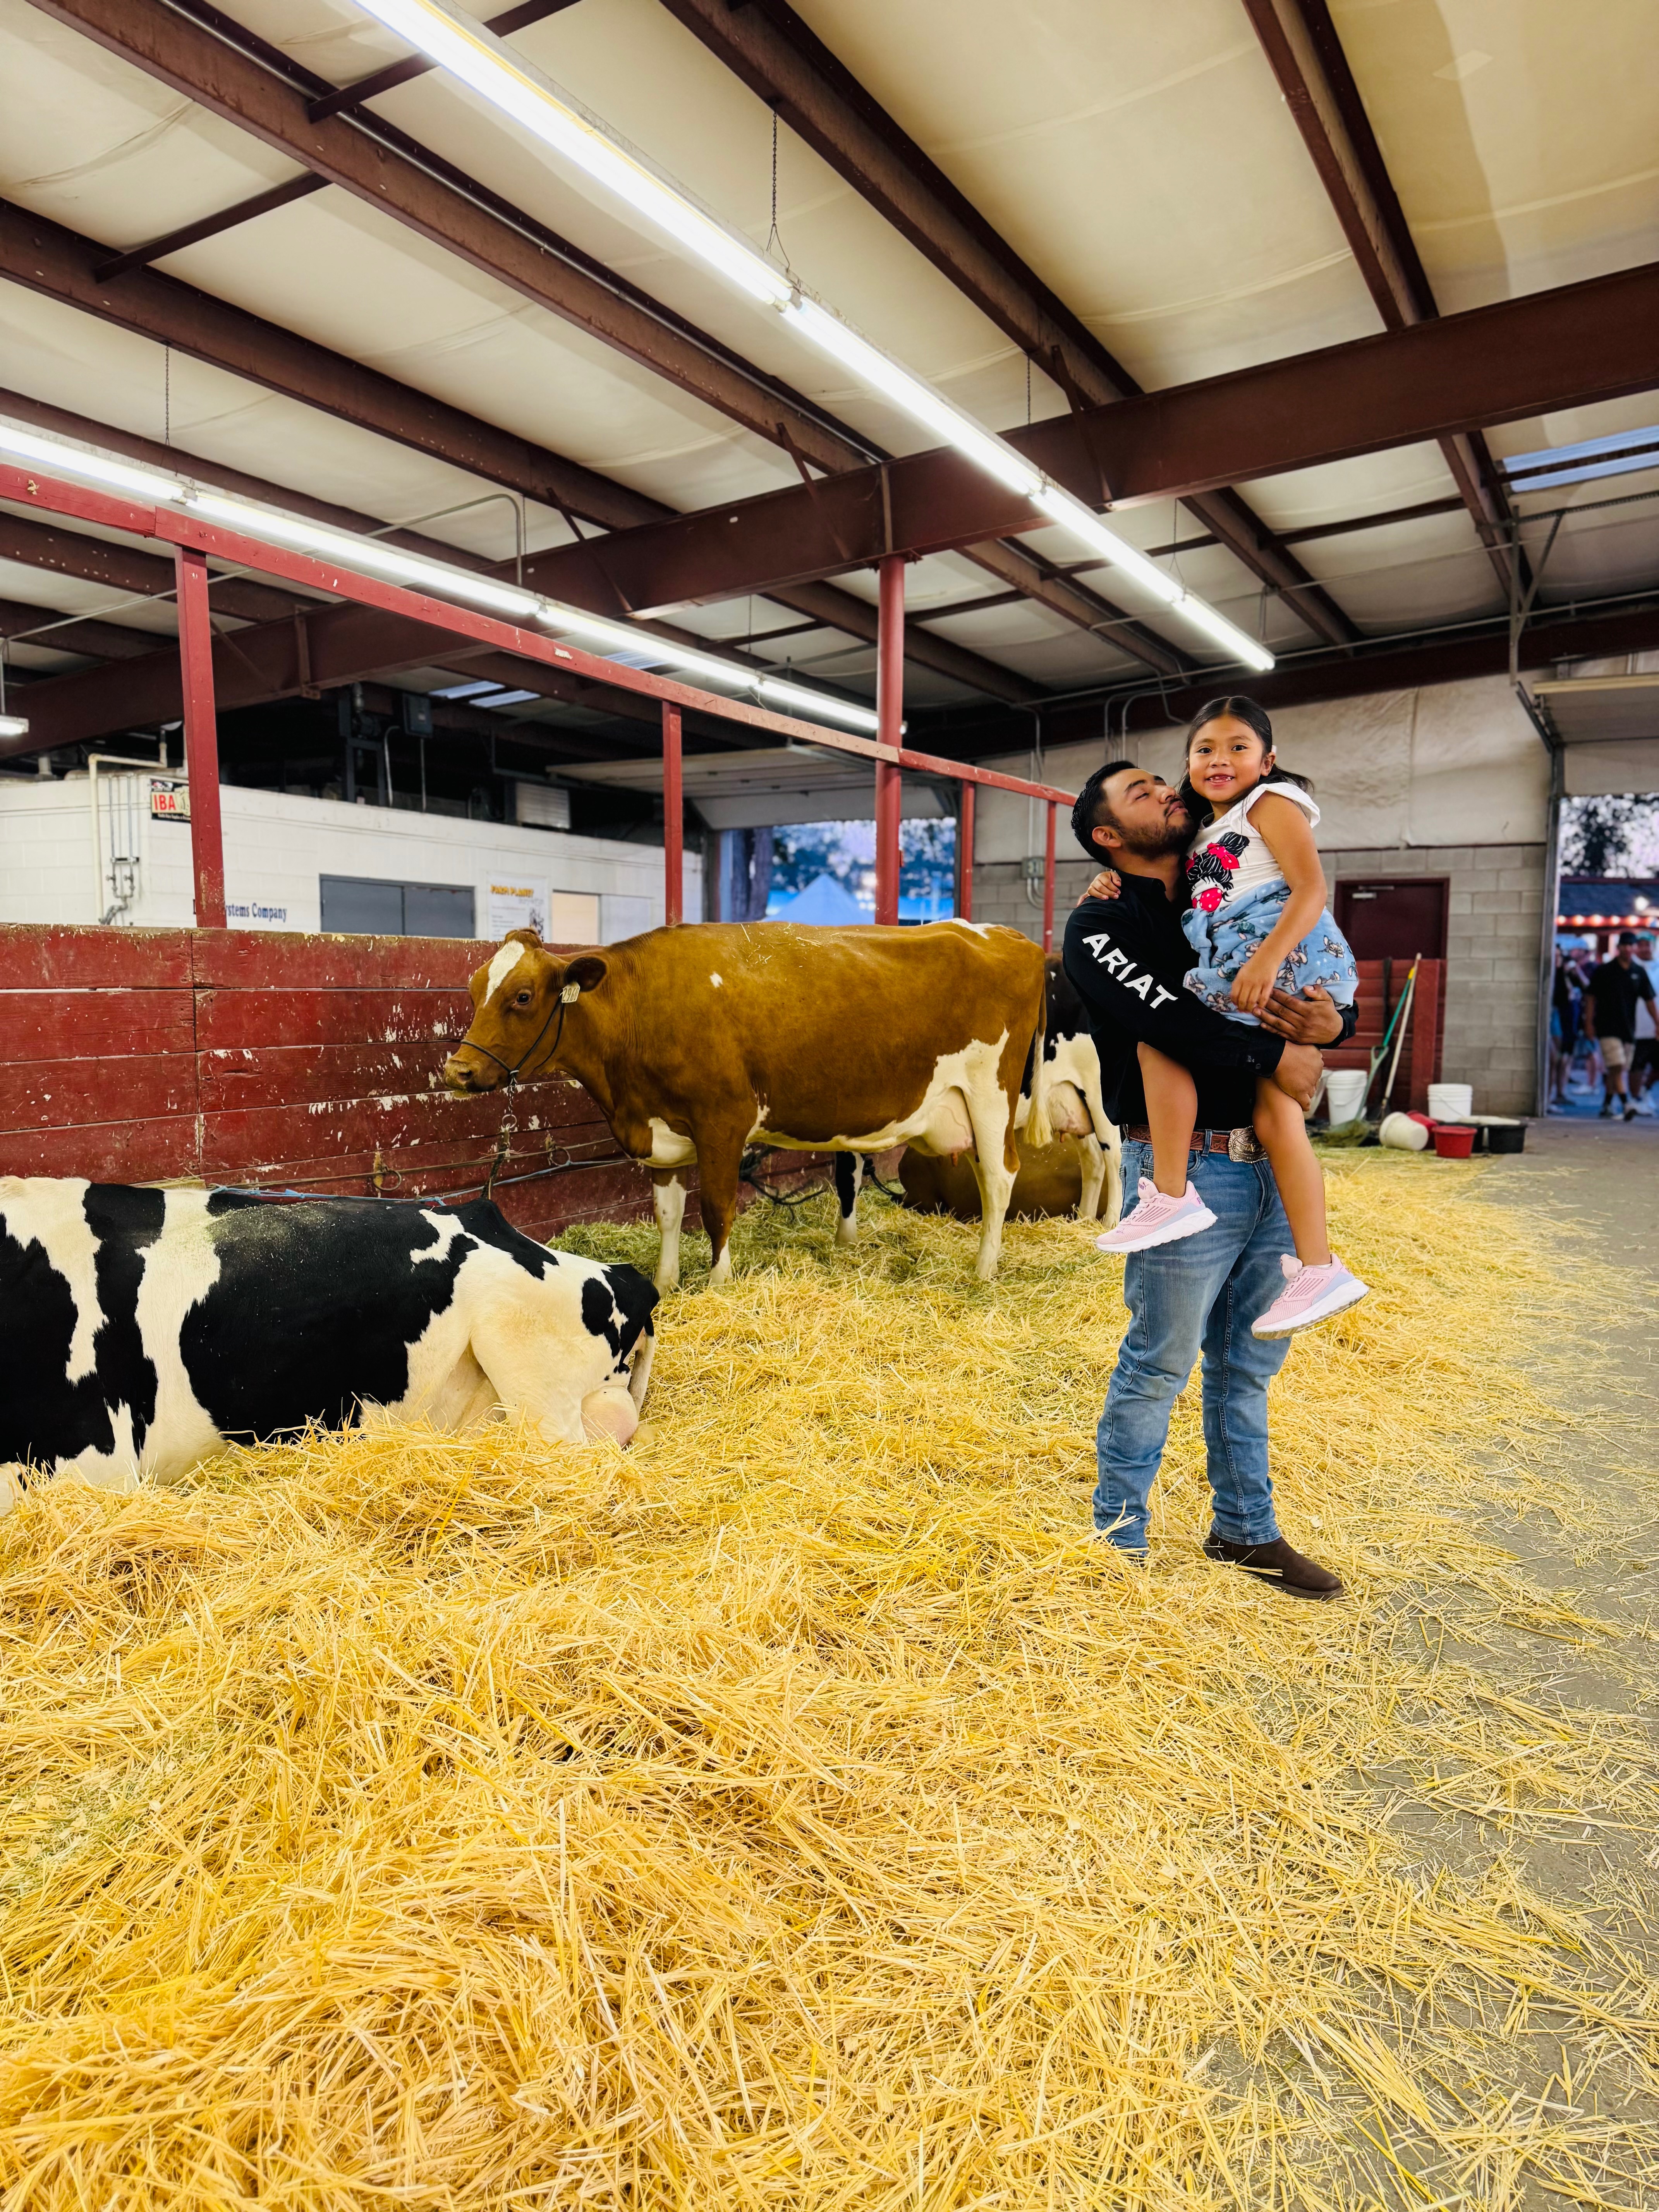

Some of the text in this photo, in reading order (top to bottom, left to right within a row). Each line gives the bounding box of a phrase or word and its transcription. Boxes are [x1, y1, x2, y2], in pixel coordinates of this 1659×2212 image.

[154, 794, 176, 811] IBA
[252, 902, 287, 923] Company
[1082, 934, 1178, 1009] ARIAT
